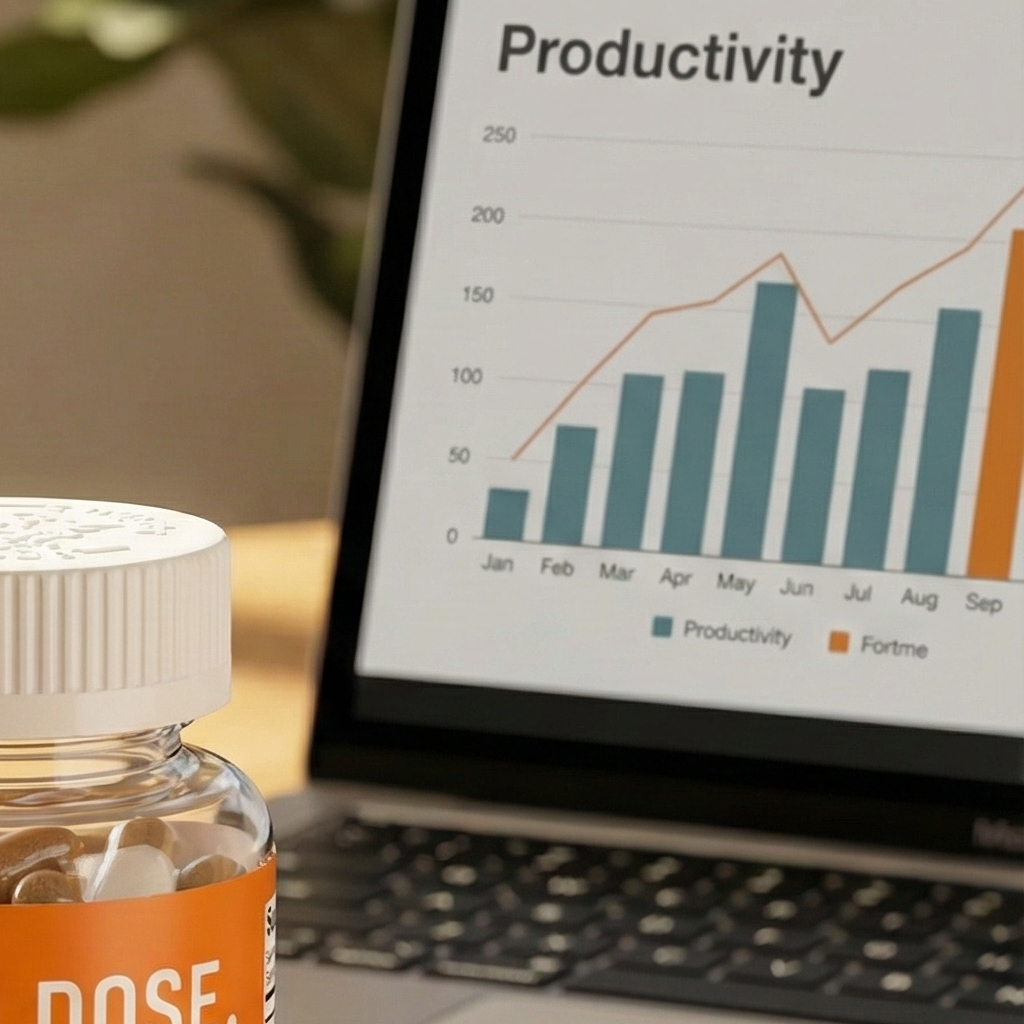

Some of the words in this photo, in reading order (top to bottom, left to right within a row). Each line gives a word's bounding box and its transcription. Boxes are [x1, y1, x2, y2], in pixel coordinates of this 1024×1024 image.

[497, 23, 845, 97] Productivity
[483, 125, 517, 144] 250
[471, 206, 506, 225] 200
[463, 286, 494, 304] 150
[451, 366, 483, 386] 100
[449, 446, 470, 465] 50
[447, 527, 459, 545] 0
[481, 554, 514, 573] Jan
[540, 557, 574, 578] Feb
[599, 562, 636, 583] Mar
[660, 568, 693, 588] Apr
[717, 572, 756, 596] May
[779, 578, 814, 599] Jun
[844, 583, 872, 604] Jul
[901, 588, 939, 612] Aug
[966, 593, 1003, 616] Sep
[684, 619, 792, 650] Productivity
[860, 635, 929, 660] Fortme
